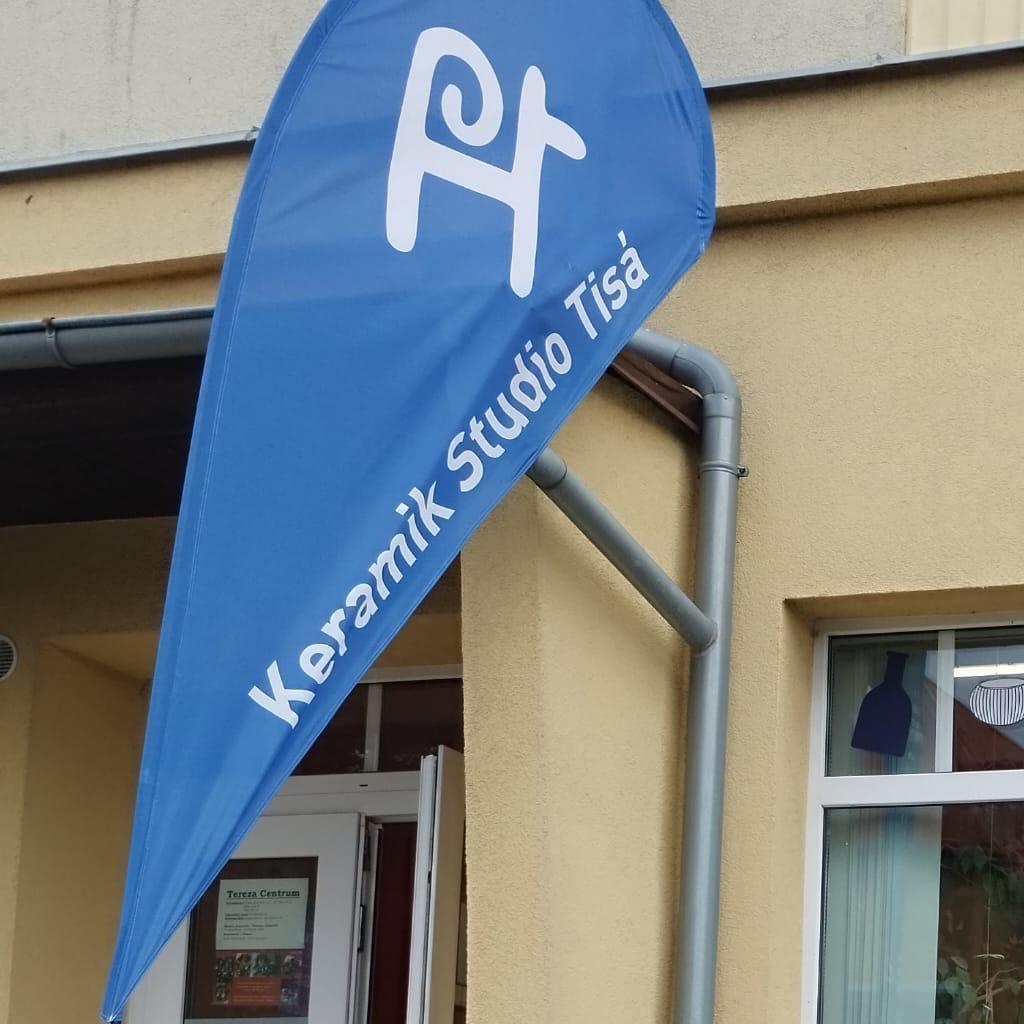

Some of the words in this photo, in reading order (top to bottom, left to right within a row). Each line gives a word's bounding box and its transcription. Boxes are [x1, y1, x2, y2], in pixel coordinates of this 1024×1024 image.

[248, 481, 455, 729] Keramik
[447, 332, 573, 492] Studio
[564, 231, 650, 340] Tisá
[227, 889, 257, 899] Tereza
[260, 888, 301, 898] Centrum
